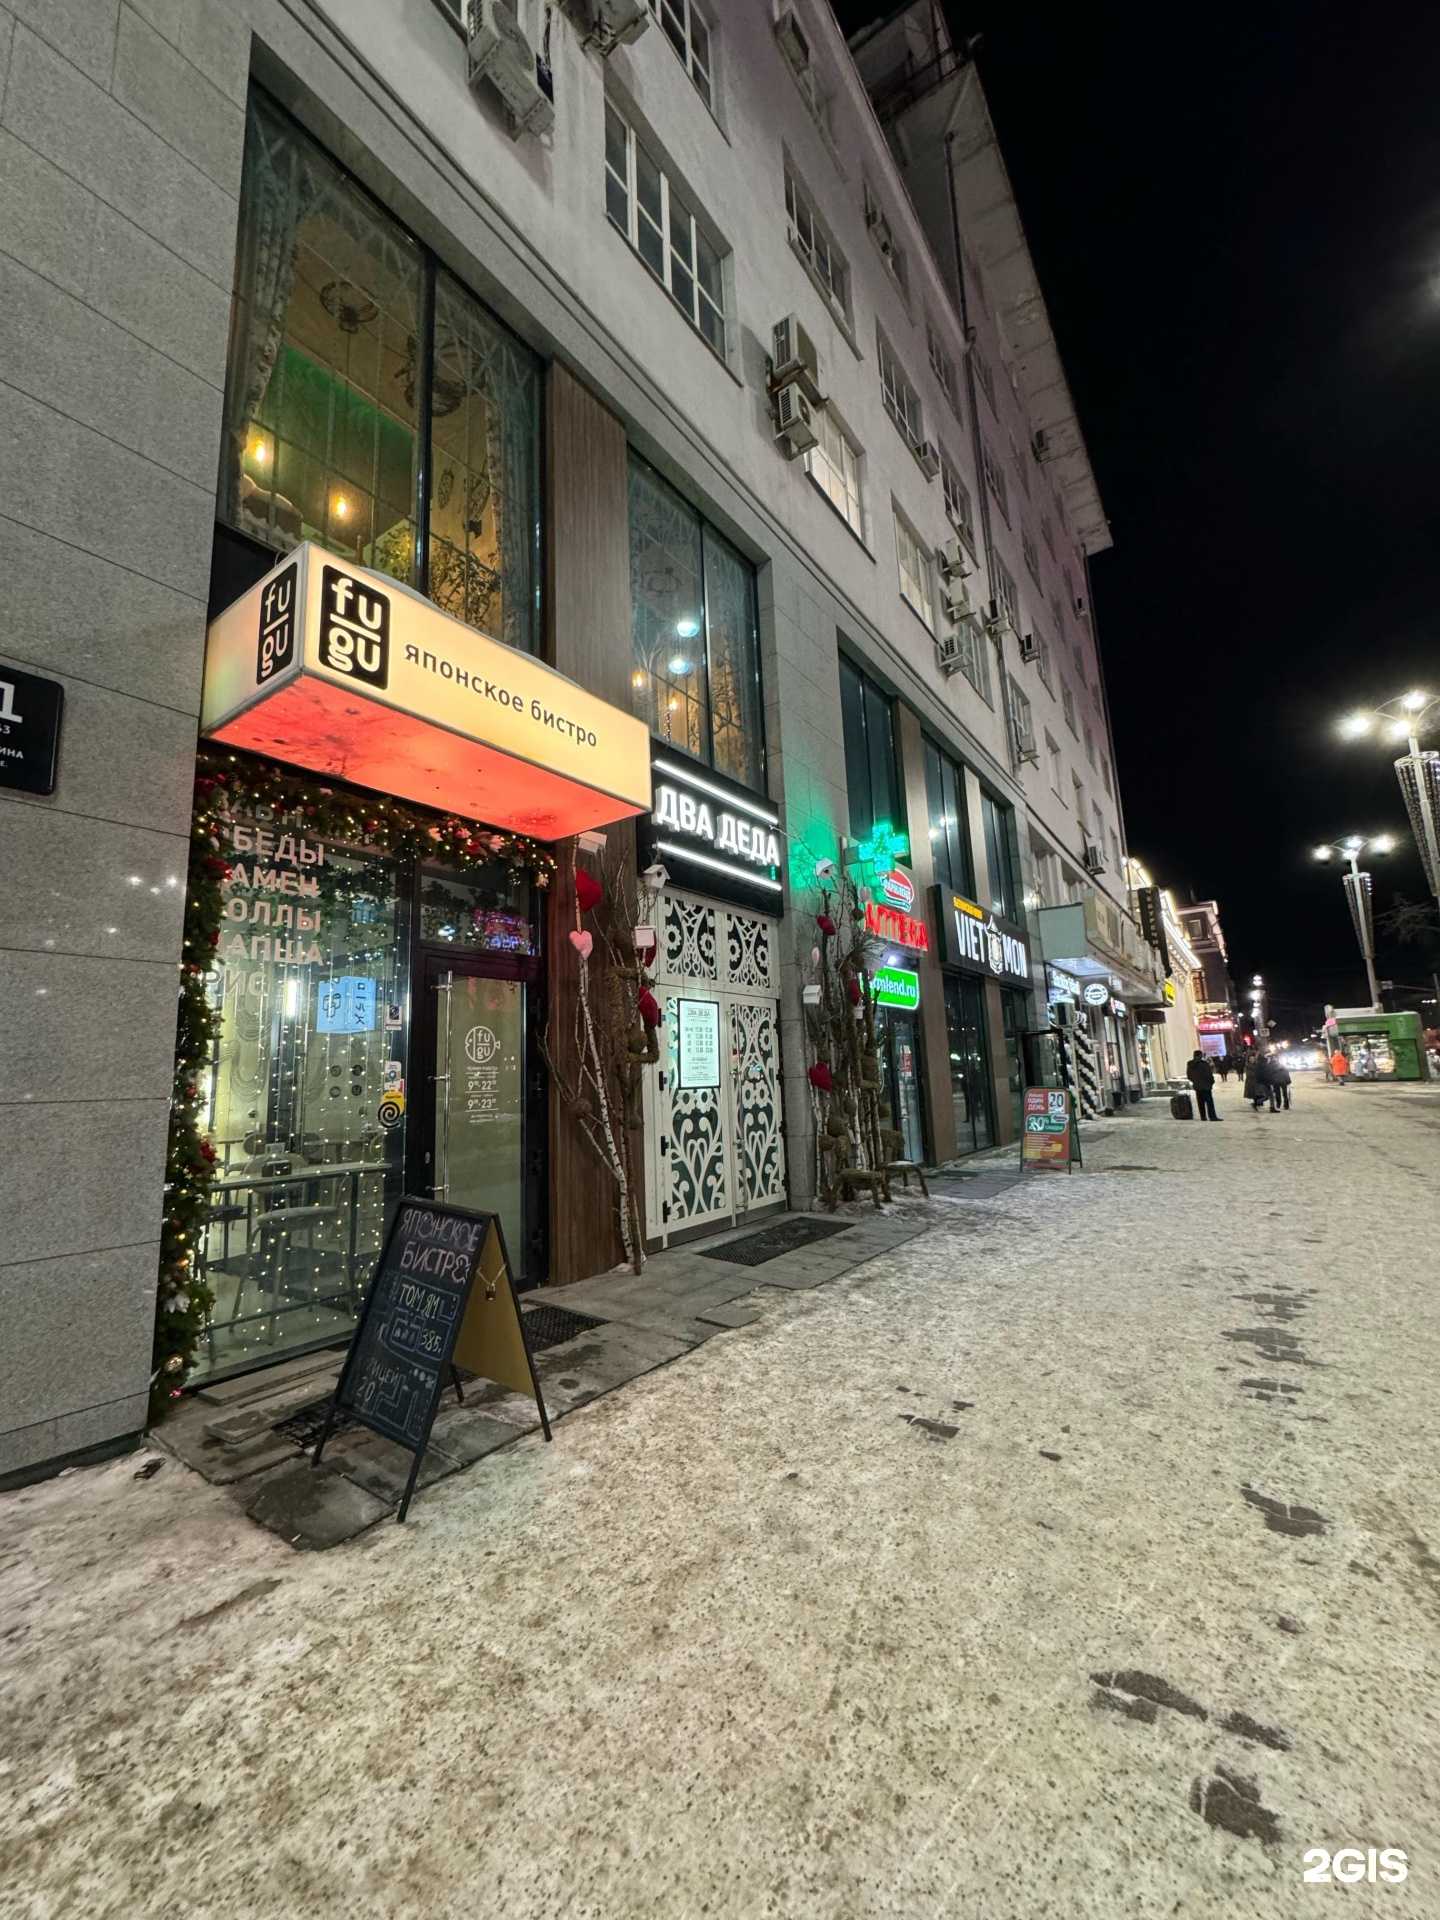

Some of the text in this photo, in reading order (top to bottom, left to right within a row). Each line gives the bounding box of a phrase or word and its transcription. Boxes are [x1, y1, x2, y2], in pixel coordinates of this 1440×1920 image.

[265, 579, 291, 623] fu
[331, 577, 382, 630] fu
[260, 624, 288, 678] gu
[327, 626, 381, 673] gu
[404, 643, 598, 747] японское бистро
[223, 824, 325, 867] БЕДЫ
[654, 785, 781, 867] ДВА ДЕДА
[222, 861, 322, 899] АМЕН
[224, 896, 322, 932] ОЛЛЫ
[953, 909, 1028, 979] VIET MON
